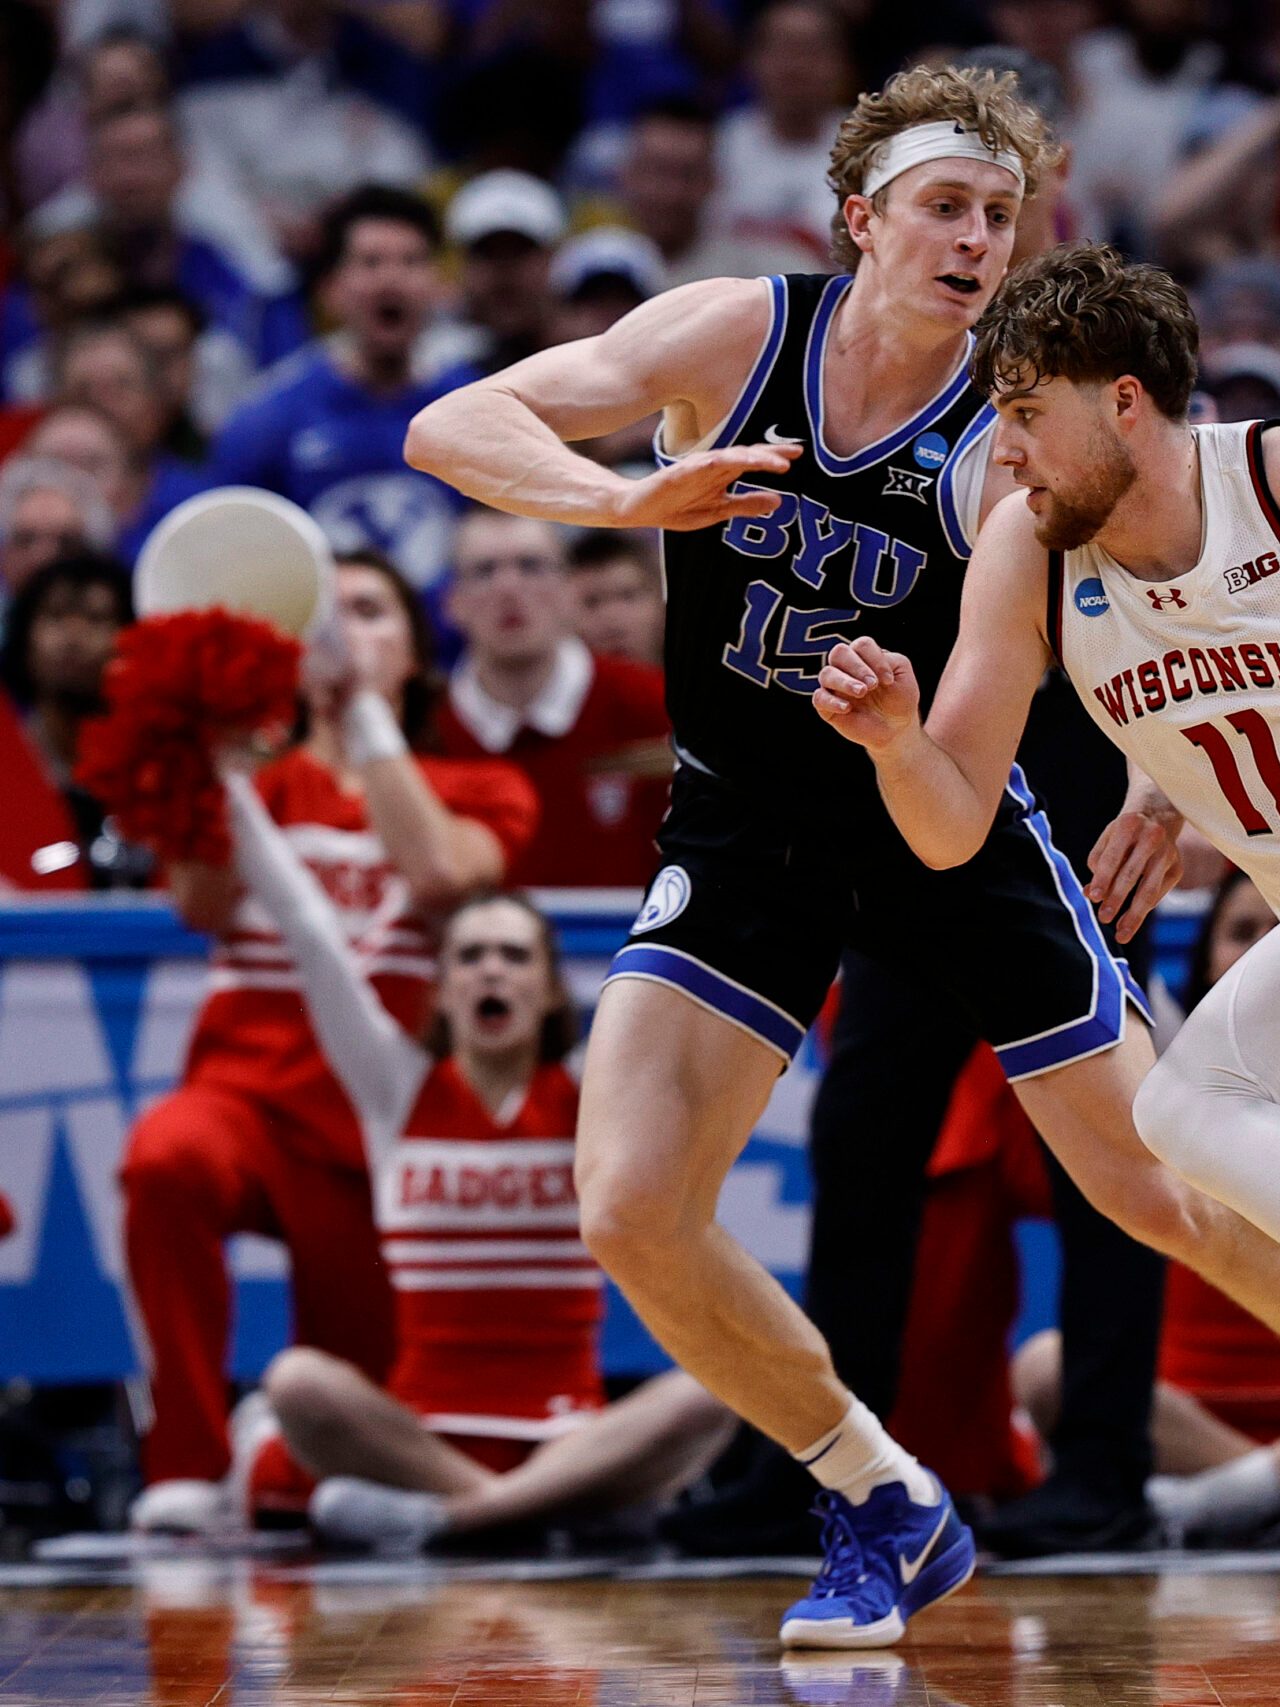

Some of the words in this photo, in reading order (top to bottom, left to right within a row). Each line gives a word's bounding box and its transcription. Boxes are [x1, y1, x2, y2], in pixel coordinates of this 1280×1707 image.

[722, 481, 928, 608] BYU
[1079, 595, 1109, 608] NCAA
[722, 579, 861, 695] 15
